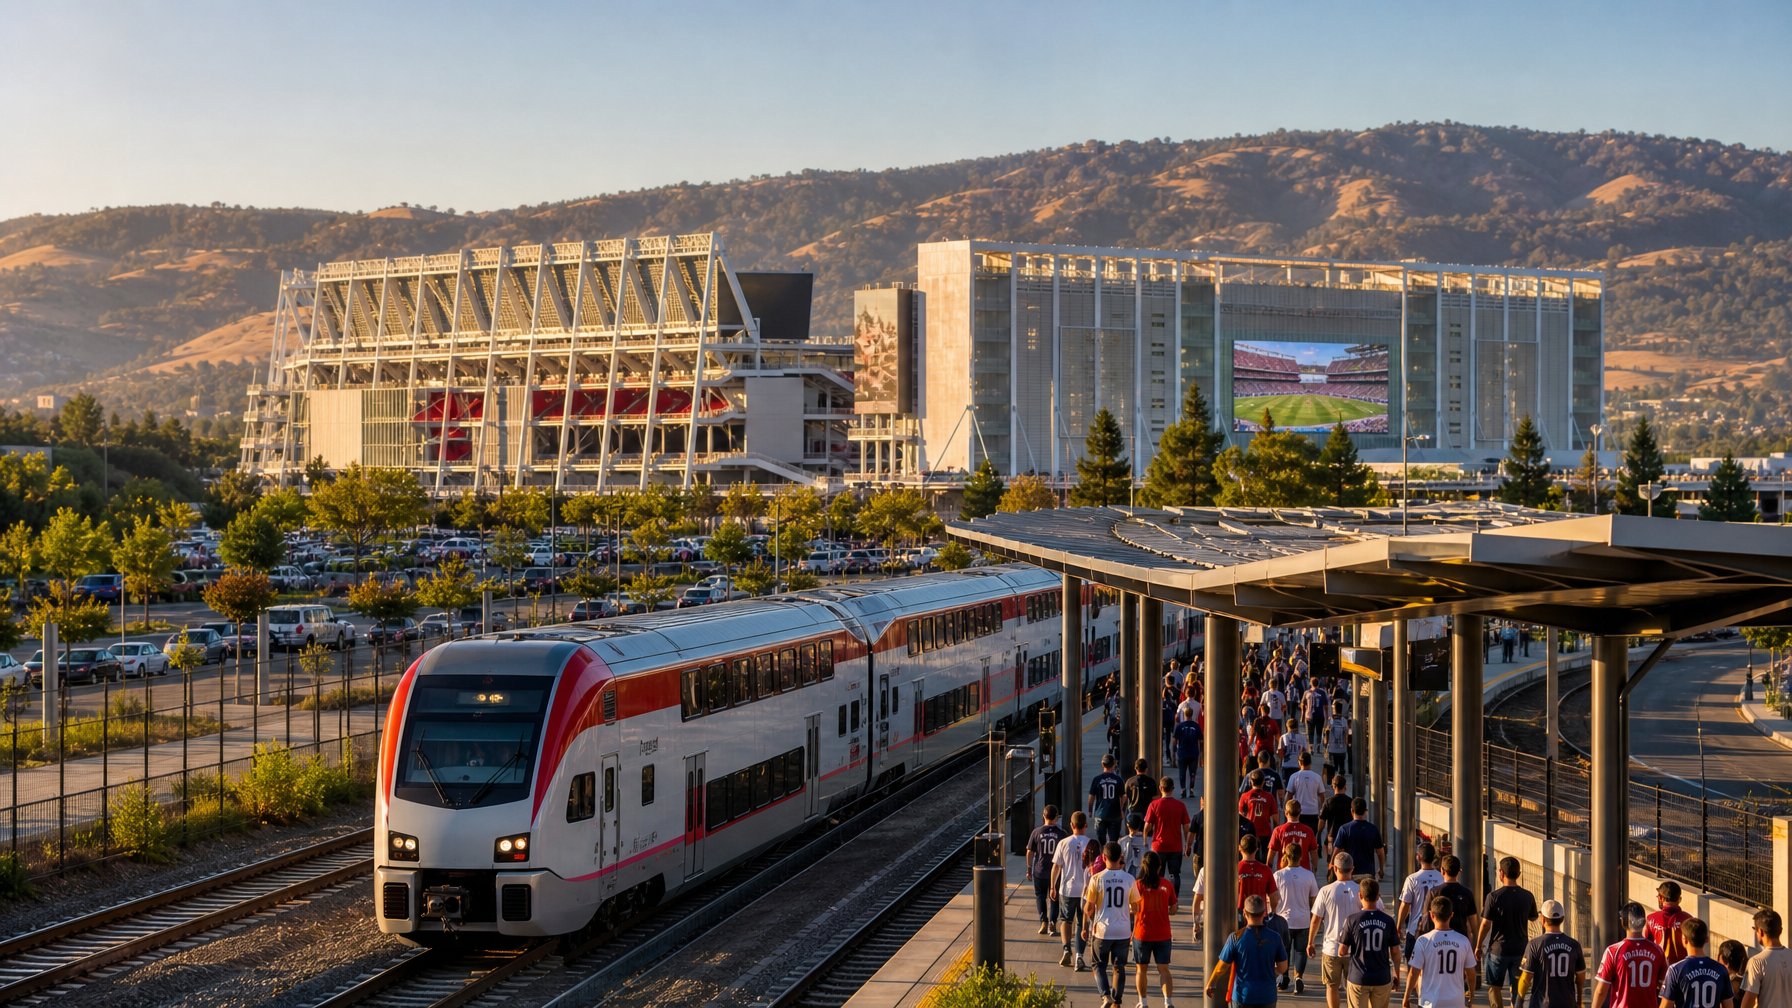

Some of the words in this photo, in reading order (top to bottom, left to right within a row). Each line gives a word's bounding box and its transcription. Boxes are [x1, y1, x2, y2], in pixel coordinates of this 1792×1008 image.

[1101, 784, 1115, 800] 10
[1041, 838, 1056, 855] 10
[1106, 886, 1124, 908] 10
[1364, 928, 1383, 951] 10
[1438, 949, 1457, 975] 10
[1548, 952, 1569, 977] 10
[1628, 960, 1652, 987] 10
[1691, 980, 1717, 1008] 10
